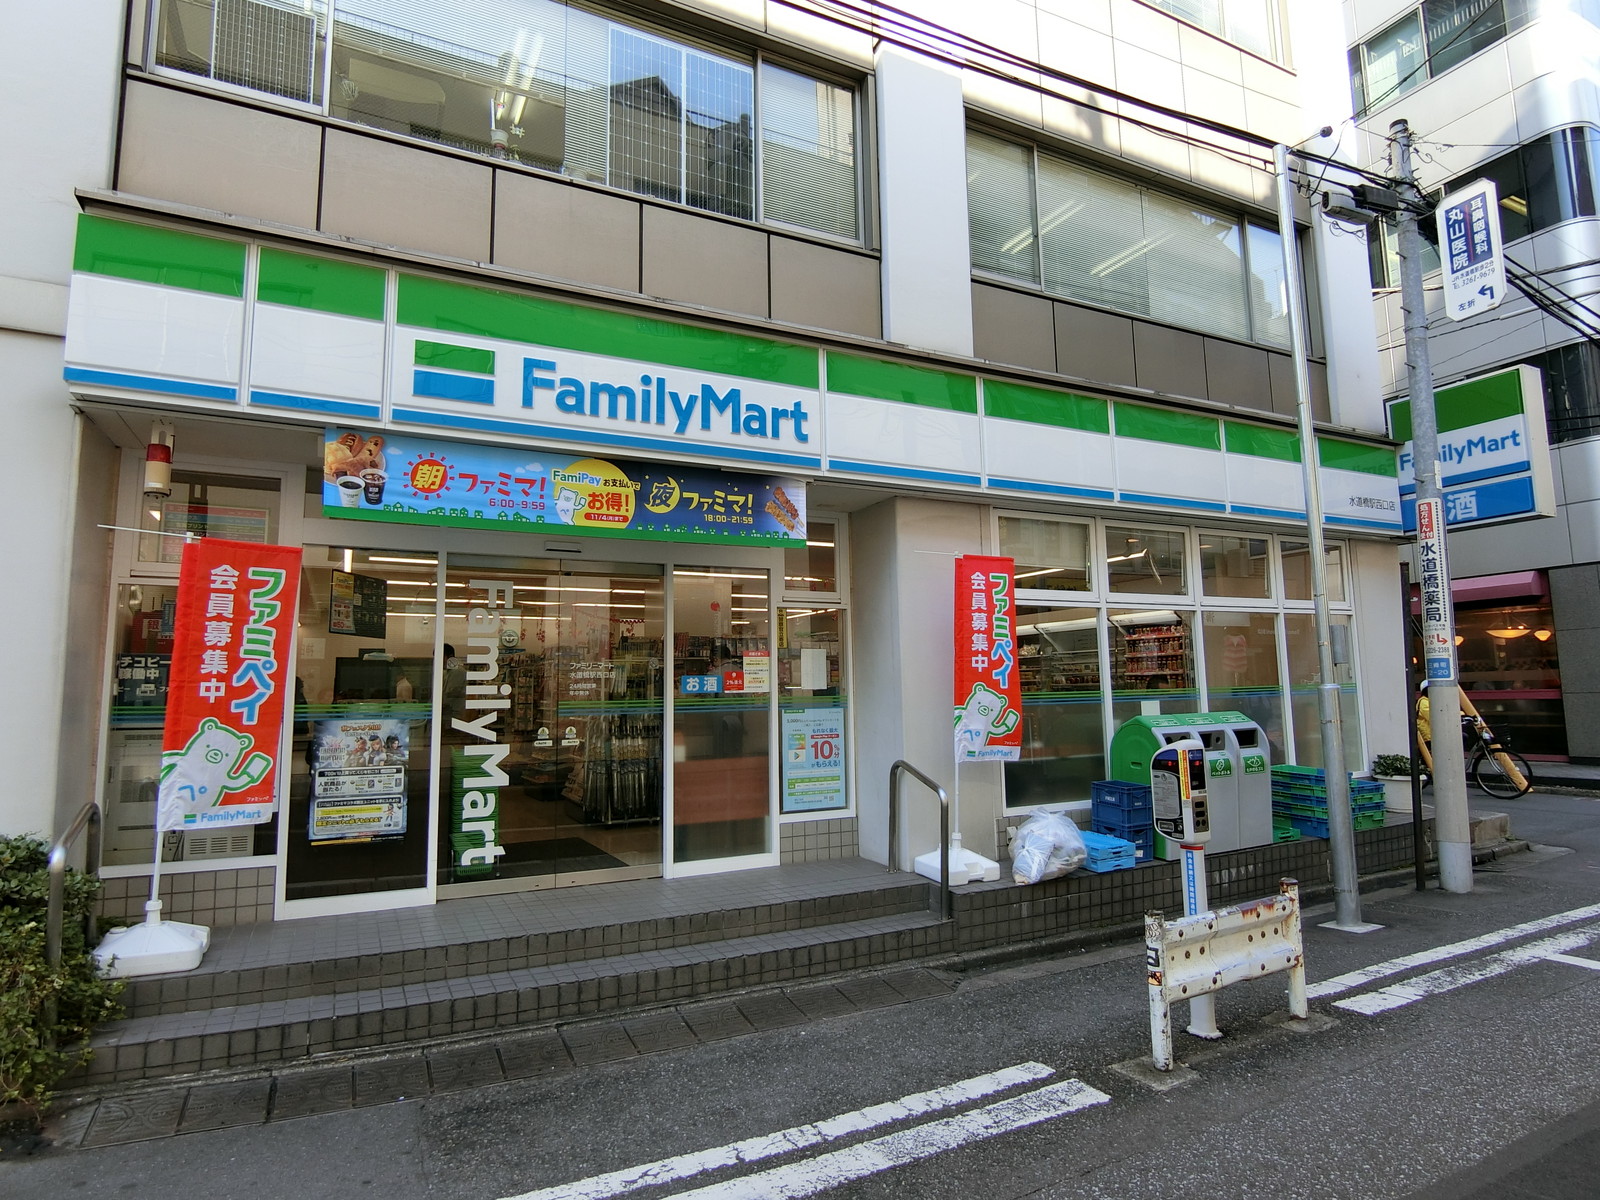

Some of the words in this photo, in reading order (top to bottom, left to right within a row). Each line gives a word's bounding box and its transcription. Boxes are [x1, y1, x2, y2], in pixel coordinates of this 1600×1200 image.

[1448, 208, 1469, 271] 丸山医院
[1470, 197, 1488, 255] 耳鼻咽喉科
[1458, 299, 1475, 311] 左折
[521, 356, 809, 444] FamilyMart
[1399, 430, 1521, 471] FilyMart
[413, 464, 446, 490] 朝
[553, 470, 601, 486] FamiPay
[603, 478, 640, 490] お支払いで
[587, 492, 629, 513] お得!
[1349, 495, 1396, 512] 水道橋駅西口店
[1448, 490, 1478, 521] 酒
[1421, 541, 1442, 623] 水道橋薬局
[199, 564, 240, 704] 会員募集中
[971, 572, 989, 672] 会員募集中
[990, 573, 1013, 688] ファミペイ
[231, 567, 286, 725] ファミペイ
[569, 662, 615, 670] ファミリーマート
[569, 671, 616, 679] 水道橋駅西口店
[686, 677, 718, 692] お酒
[451, 579, 515, 867] FamilyMart
[978, 750, 1013, 758] FamilyMart
[200, 810, 261, 822] FamilyMart
